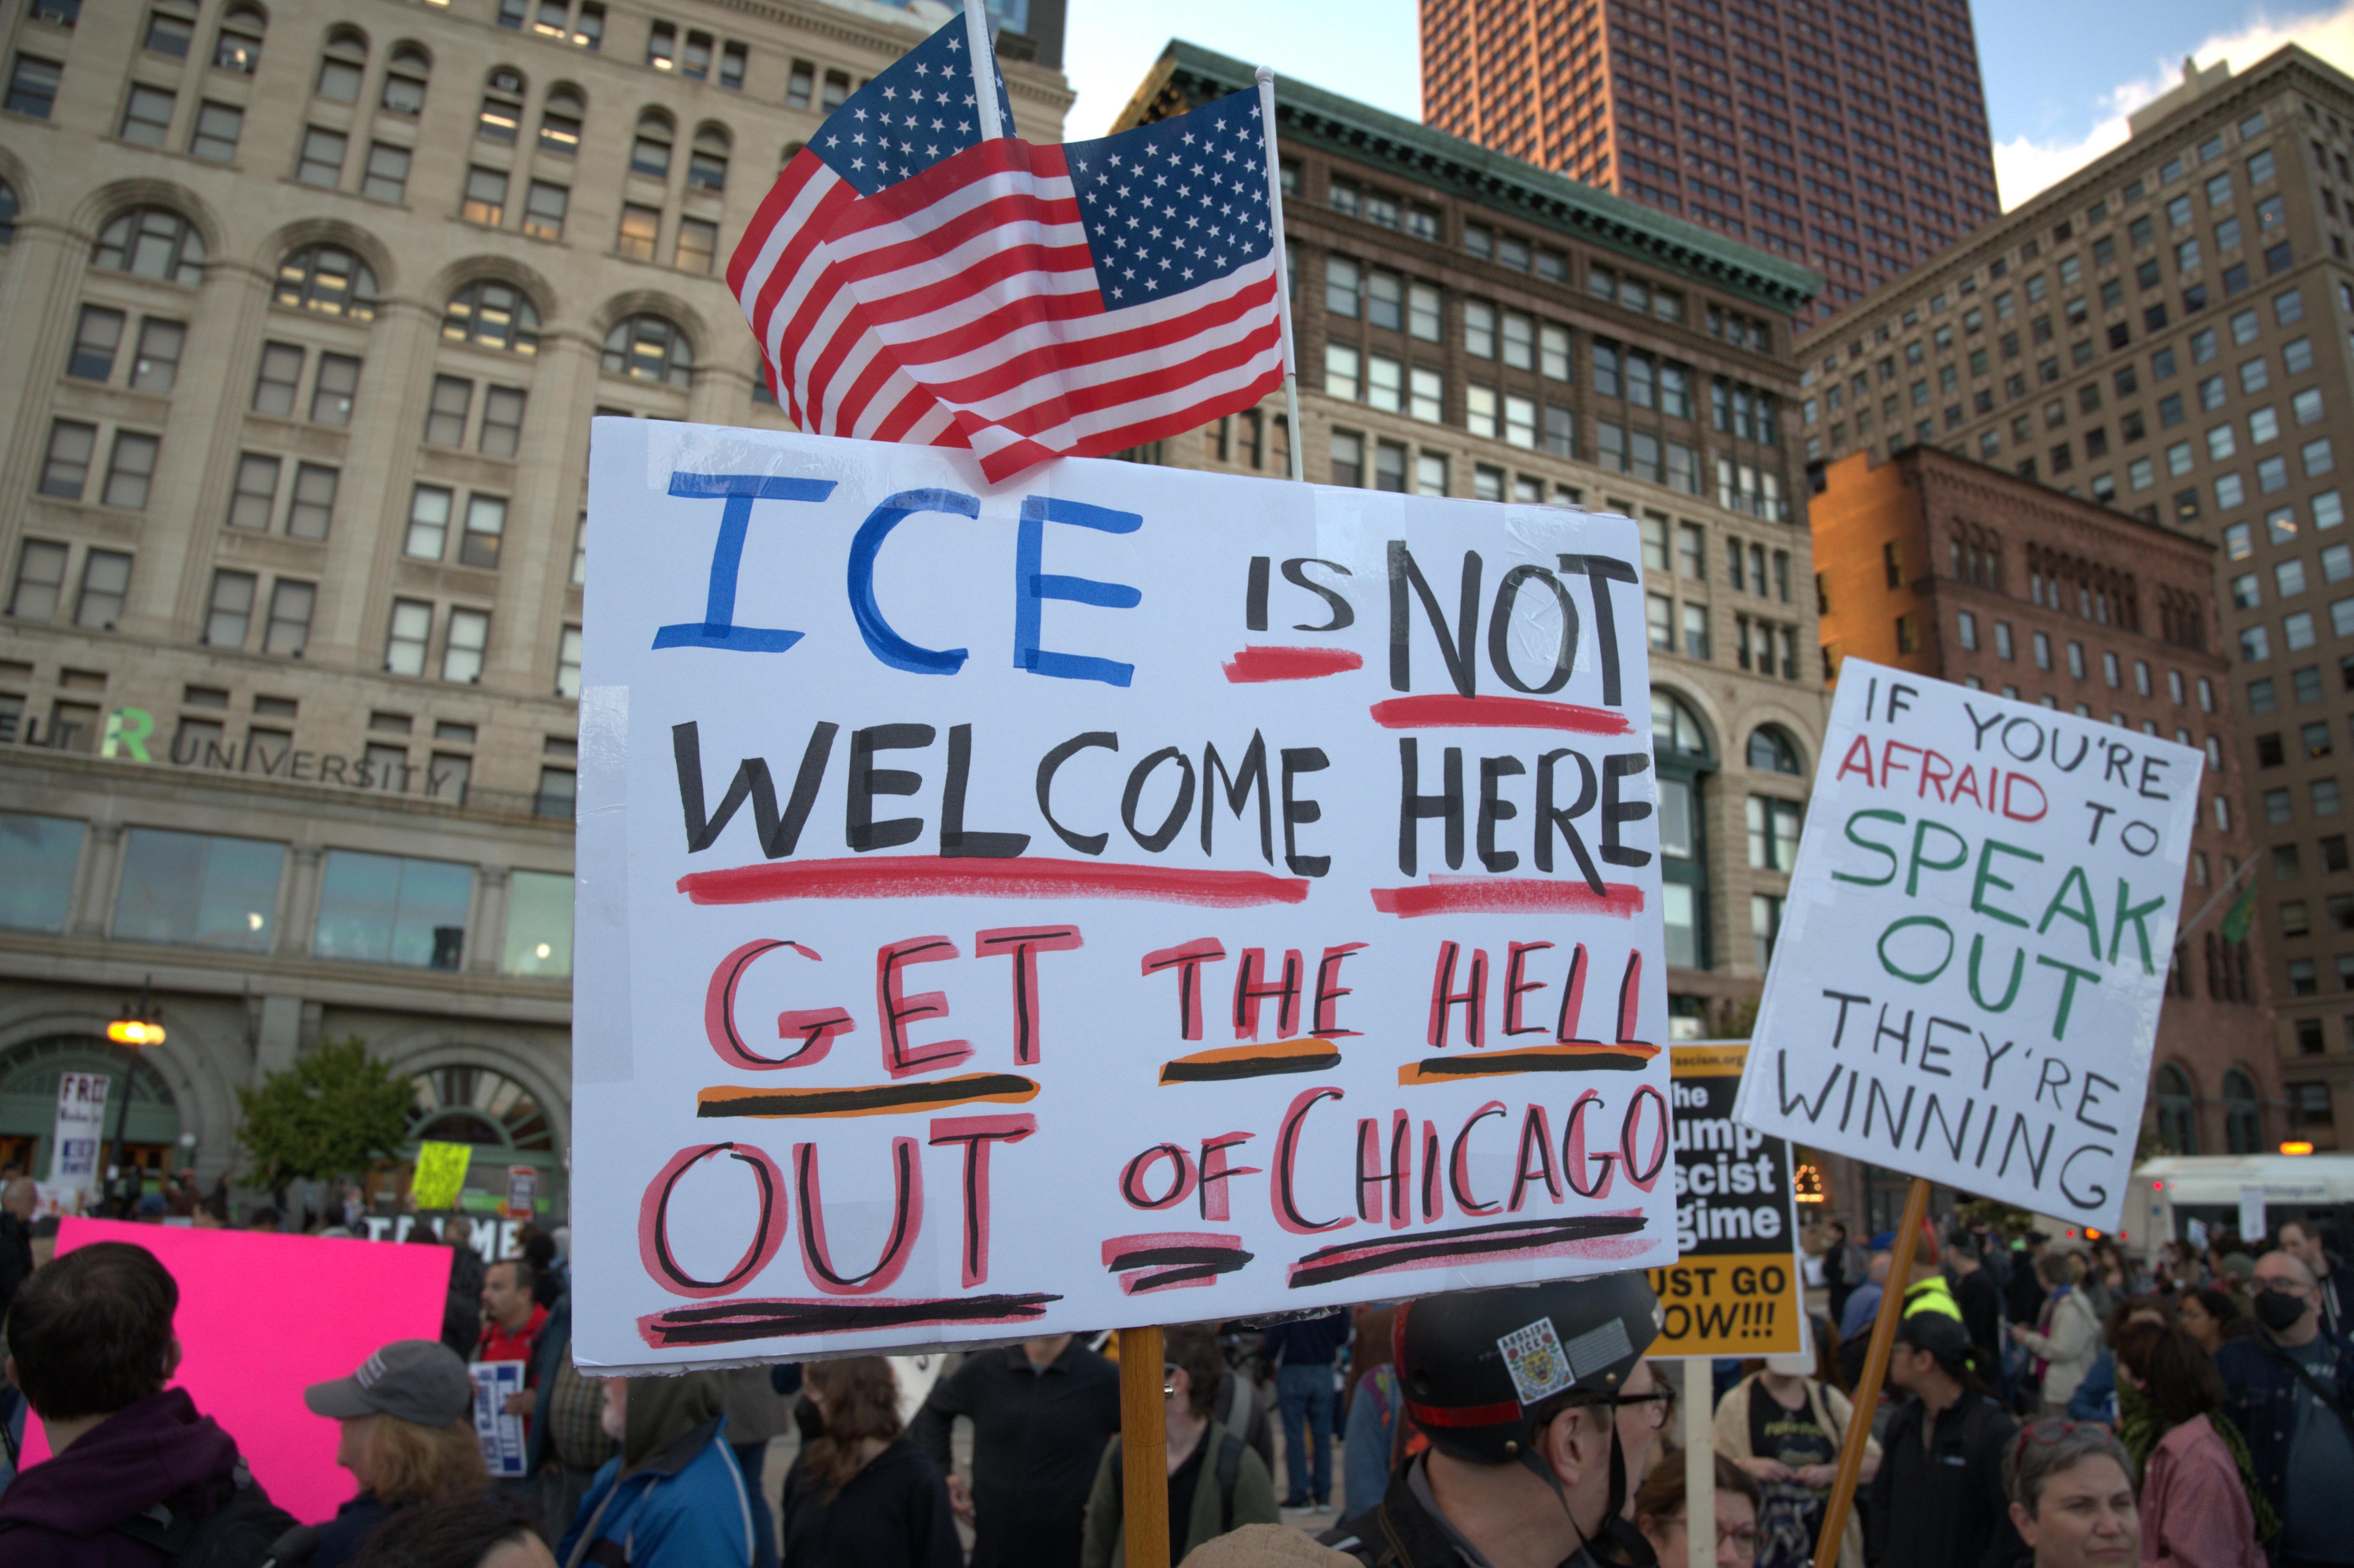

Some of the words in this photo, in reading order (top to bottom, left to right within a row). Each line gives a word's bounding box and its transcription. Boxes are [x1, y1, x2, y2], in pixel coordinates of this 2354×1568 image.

[651, 471, 1143, 687] ICE
[1246, 556, 1354, 631] IS
[1387, 540, 1638, 706] NOT
[170, 732, 453, 796] UNIVERSITY
[1836, 735, 2048, 823] AFRAID
[2085, 801, 2159, 857] TO
[1866, 677, 1919, 724] IF
[1964, 702, 2171, 801] YOU'RE
[672, 721, 1330, 877] WELCOME
[1399, 737, 1652, 896] HERE
[1831, 809, 2166, 976] SPEAK
[704, 924, 1084, 1079] GET
[1141, 937, 1370, 1042] THE
[1427, 940, 1659, 1052] HELL
[1877, 916, 2101, 1041] OUT
[1671, 1081, 1709, 1108] he
[1778, 1049, 2113, 1209] WINNING
[1822, 989, 2120, 1134] THEY'RE
[638, 1113, 1039, 1299] OUT
[1119, 1131, 1263, 1222] OF
[1270, 1085, 1670, 1235] CHICAGO
[1520, 1338, 1540, 1354] ICE
[1731, 1265, 1787, 1296] GO
